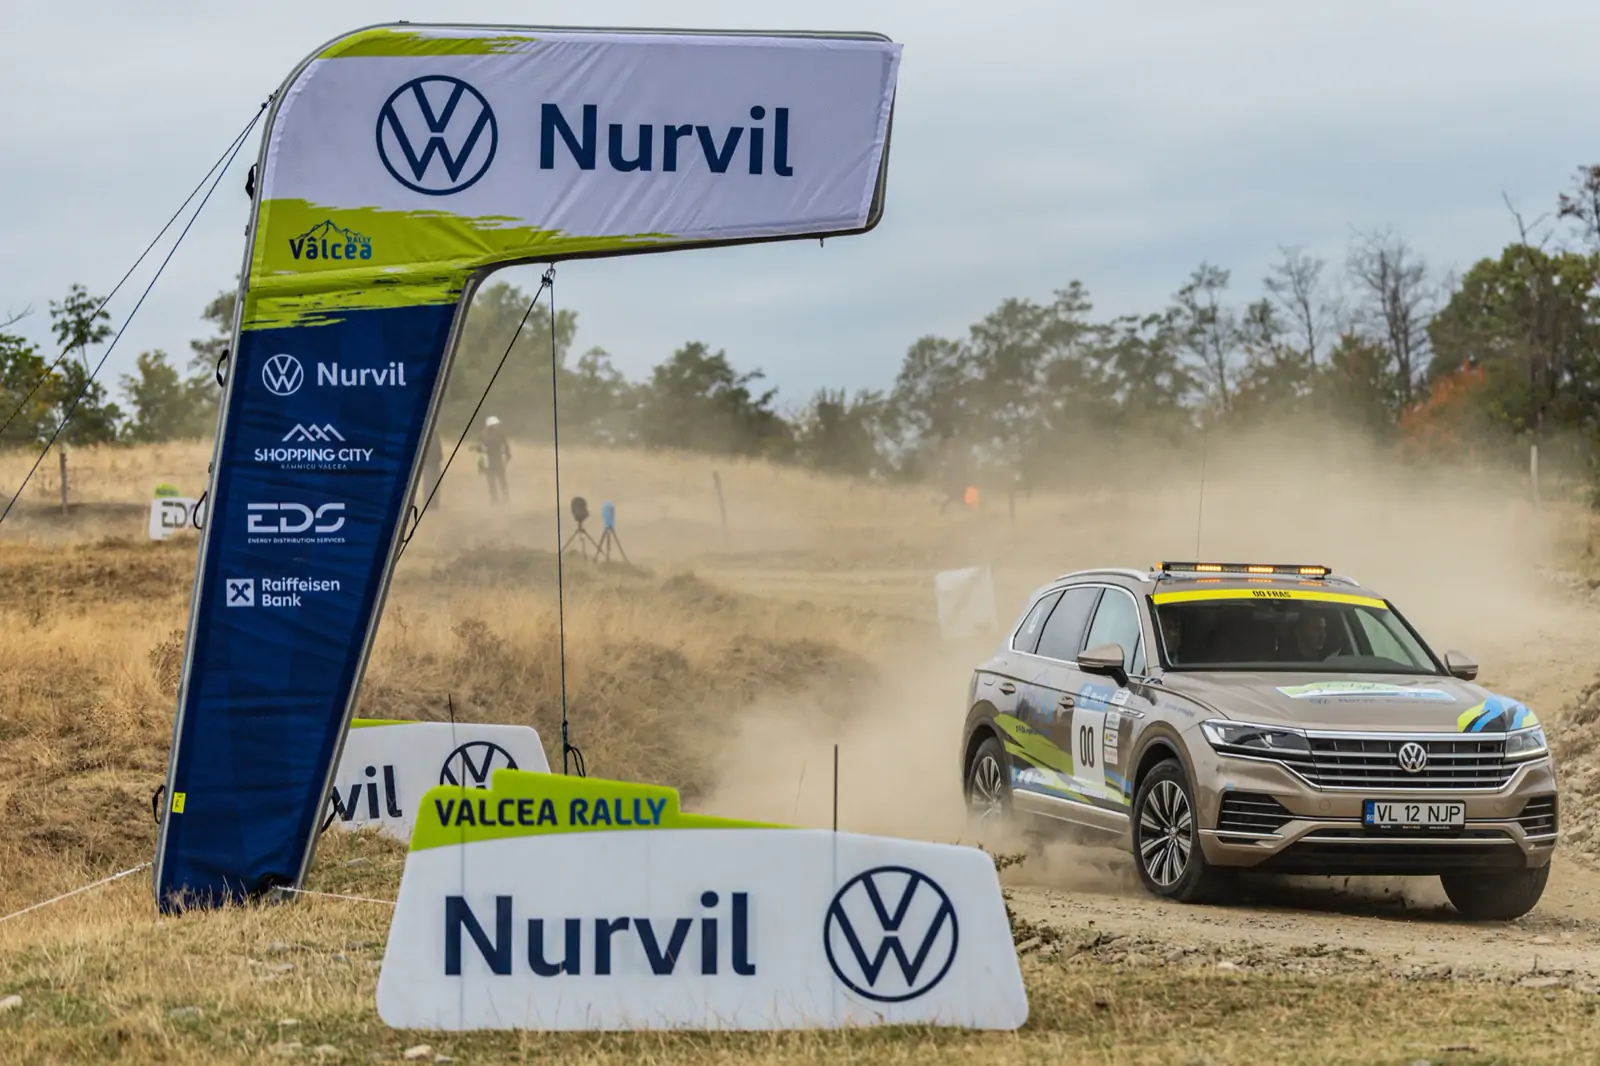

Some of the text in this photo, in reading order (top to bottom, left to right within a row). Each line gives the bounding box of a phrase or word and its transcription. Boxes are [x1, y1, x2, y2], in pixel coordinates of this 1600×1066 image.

[539, 103, 793, 177] Nurvil
[289, 236, 372, 260] Vâlcea
[317, 362, 406, 387] Nurvil
[254, 448, 374, 462] SHOPPING CITY
[247, 503, 345, 533] EDS
[262, 577, 340, 592] Raiffeisen
[262, 593, 302, 607] Bank
[1080, 725, 1094, 768] 00
[434, 797, 666, 828] VALCEA RALLY
[1377, 804, 1461, 823] VL 12 NJP
[444, 891, 756, 977] Nurvil
